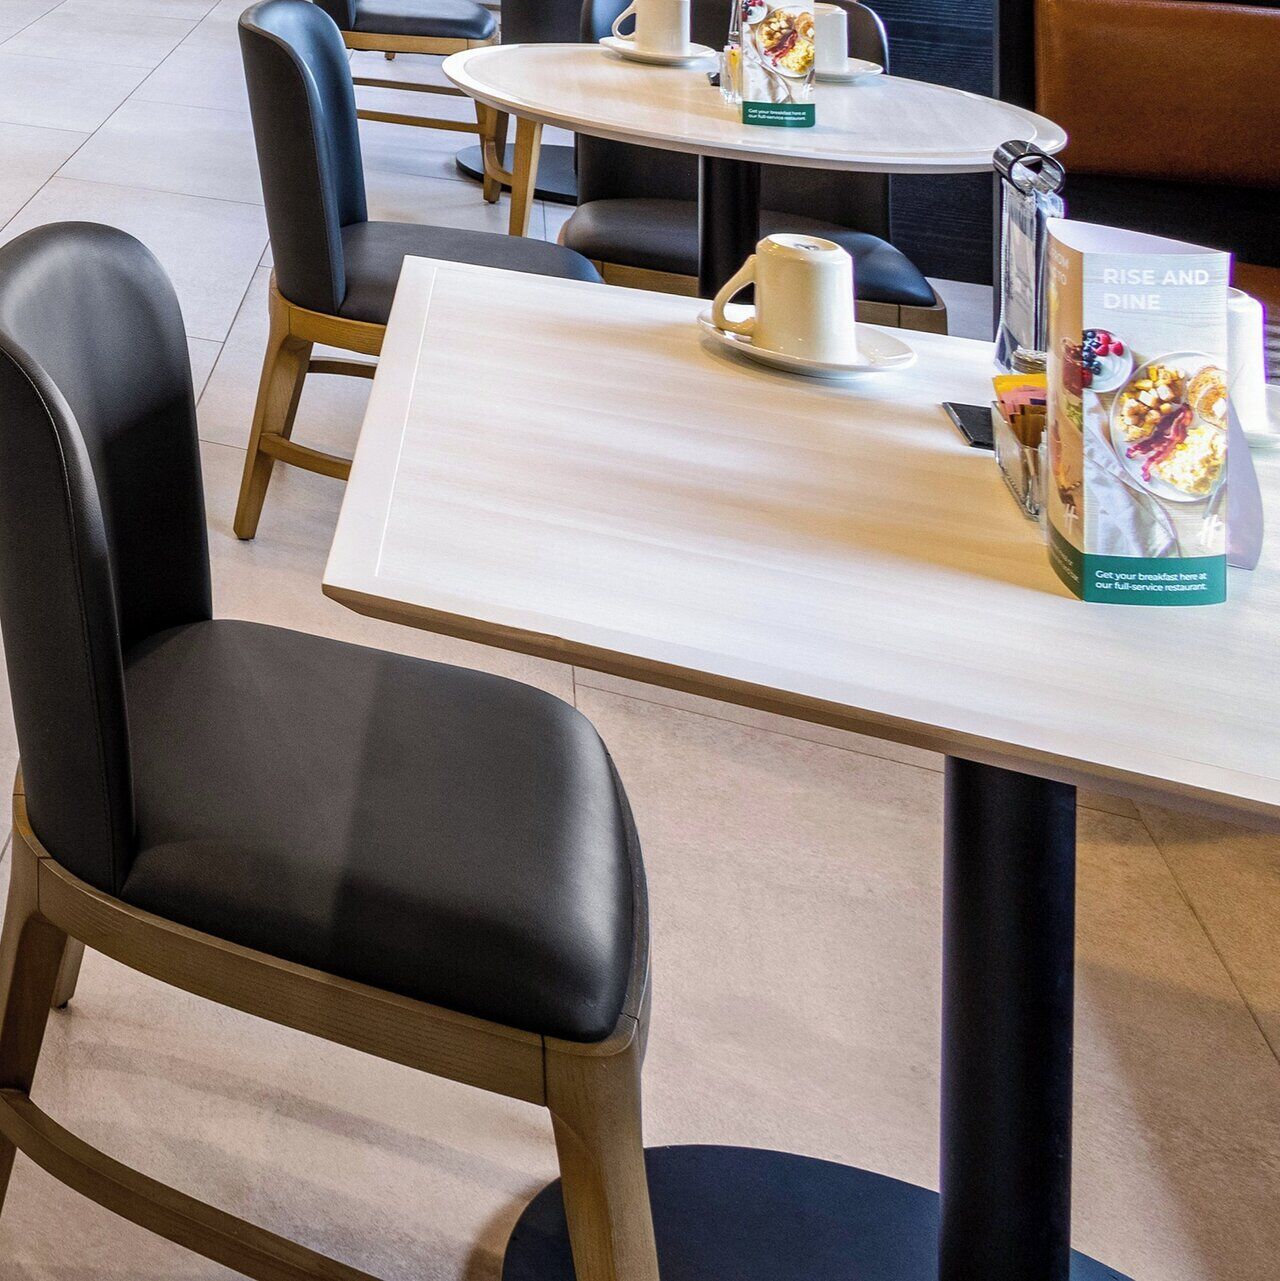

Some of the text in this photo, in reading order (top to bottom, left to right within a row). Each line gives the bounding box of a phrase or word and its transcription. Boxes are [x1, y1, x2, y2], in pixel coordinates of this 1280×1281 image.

[1104, 269, 1209, 286] RISE AND
[1104, 293, 1161, 310] DINE
[1095, 570, 1113, 580] Get
[1115, 572, 1136, 582] your
[1138, 571, 1179, 581] breakfast
[1179, 573, 1198, 581] here
[1095, 582, 1208, 592] our full-service restaurant.
